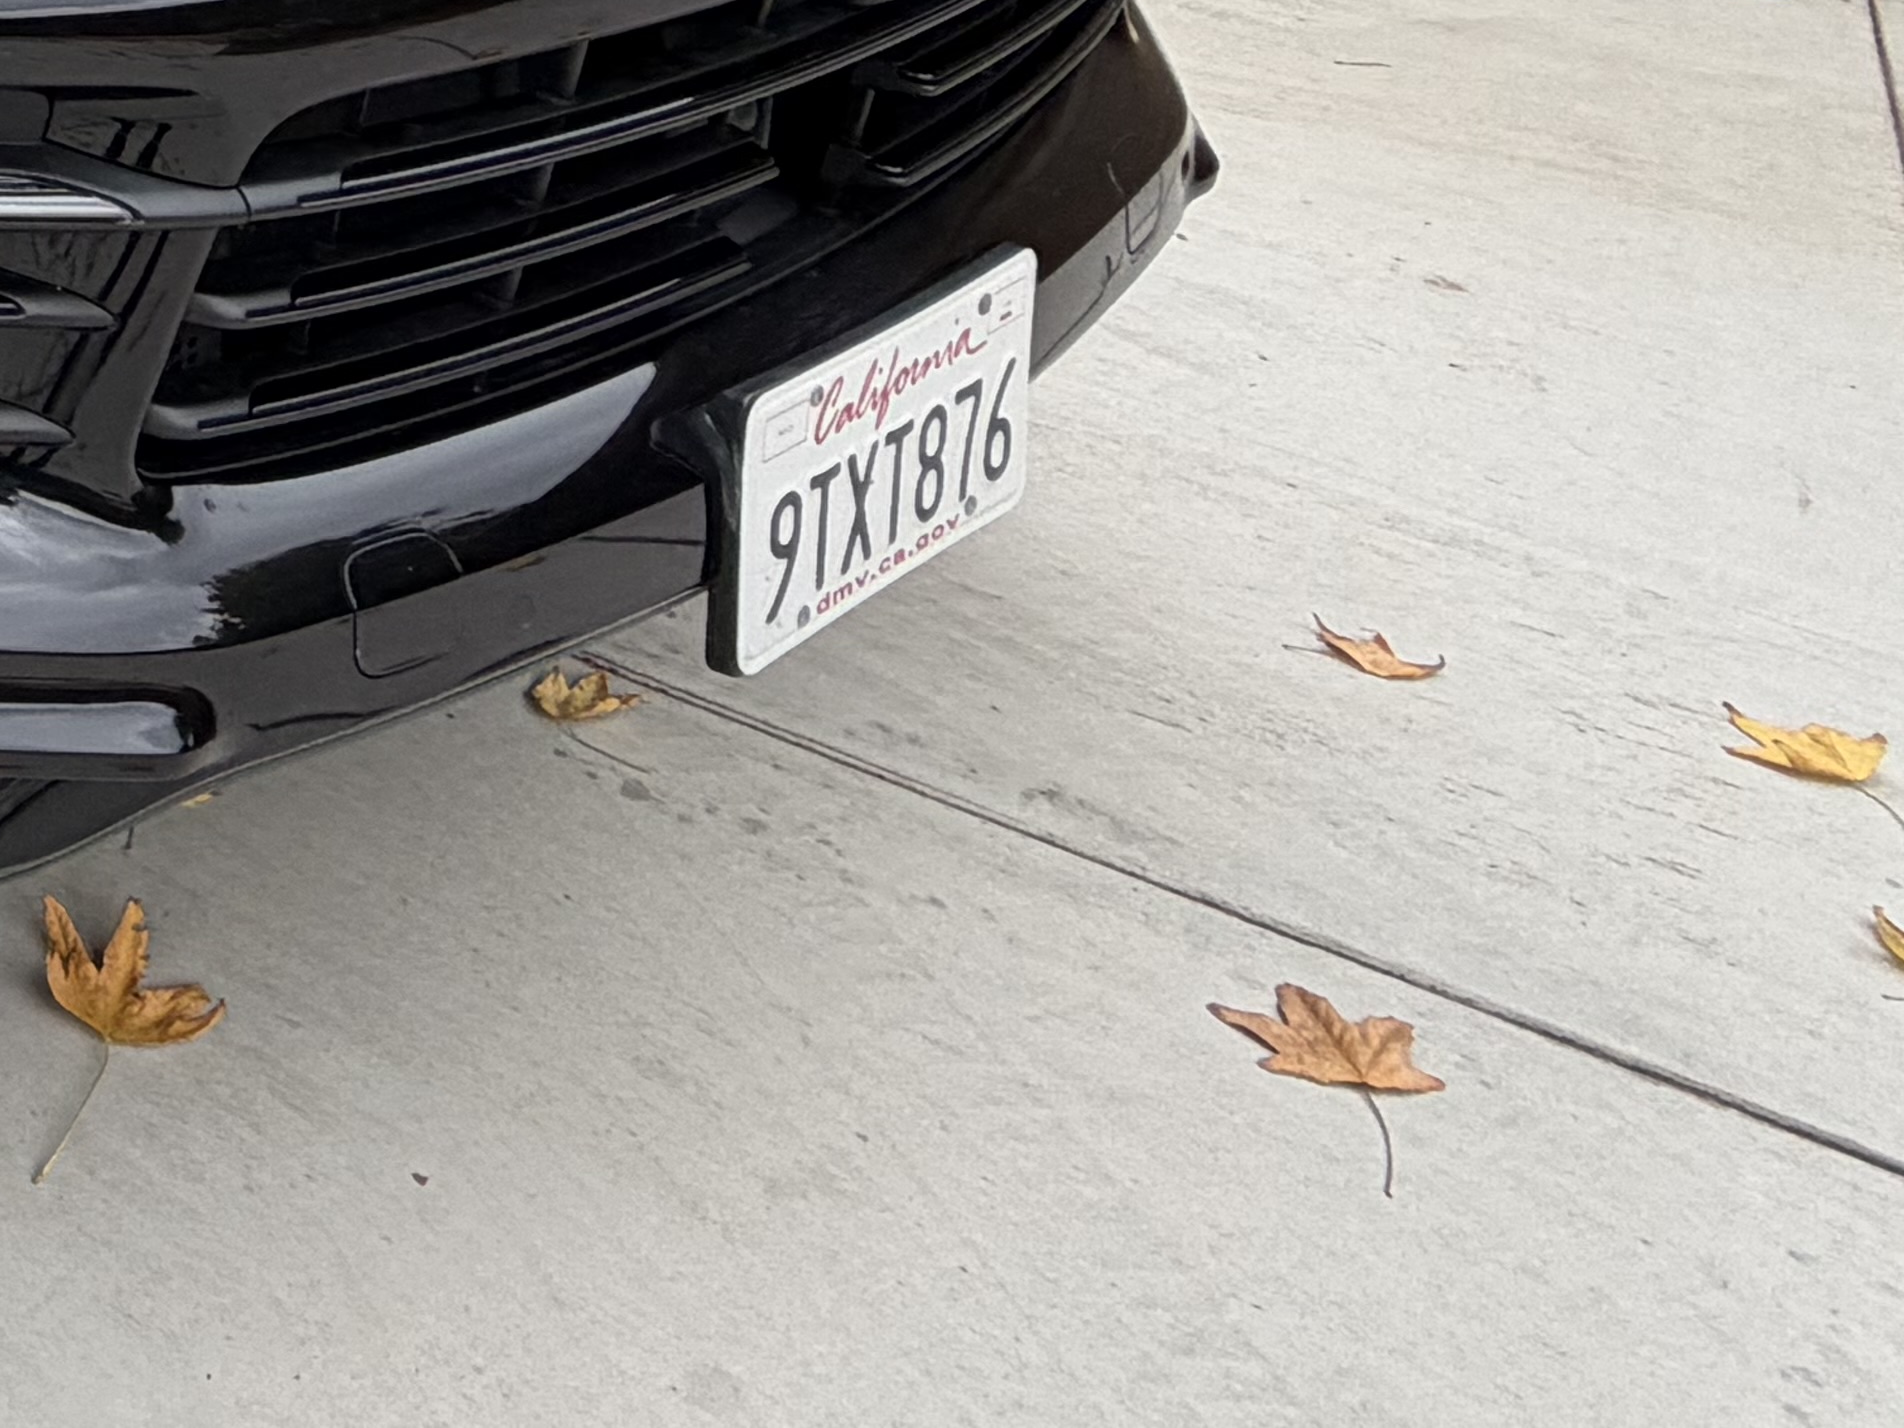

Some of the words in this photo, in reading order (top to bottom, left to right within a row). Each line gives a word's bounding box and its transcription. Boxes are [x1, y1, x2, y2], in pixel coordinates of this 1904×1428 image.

[813, 317, 987, 445] California
[765, 357, 1017, 625] 9TXT876
[816, 513, 961, 615] dmv.ca.gov
